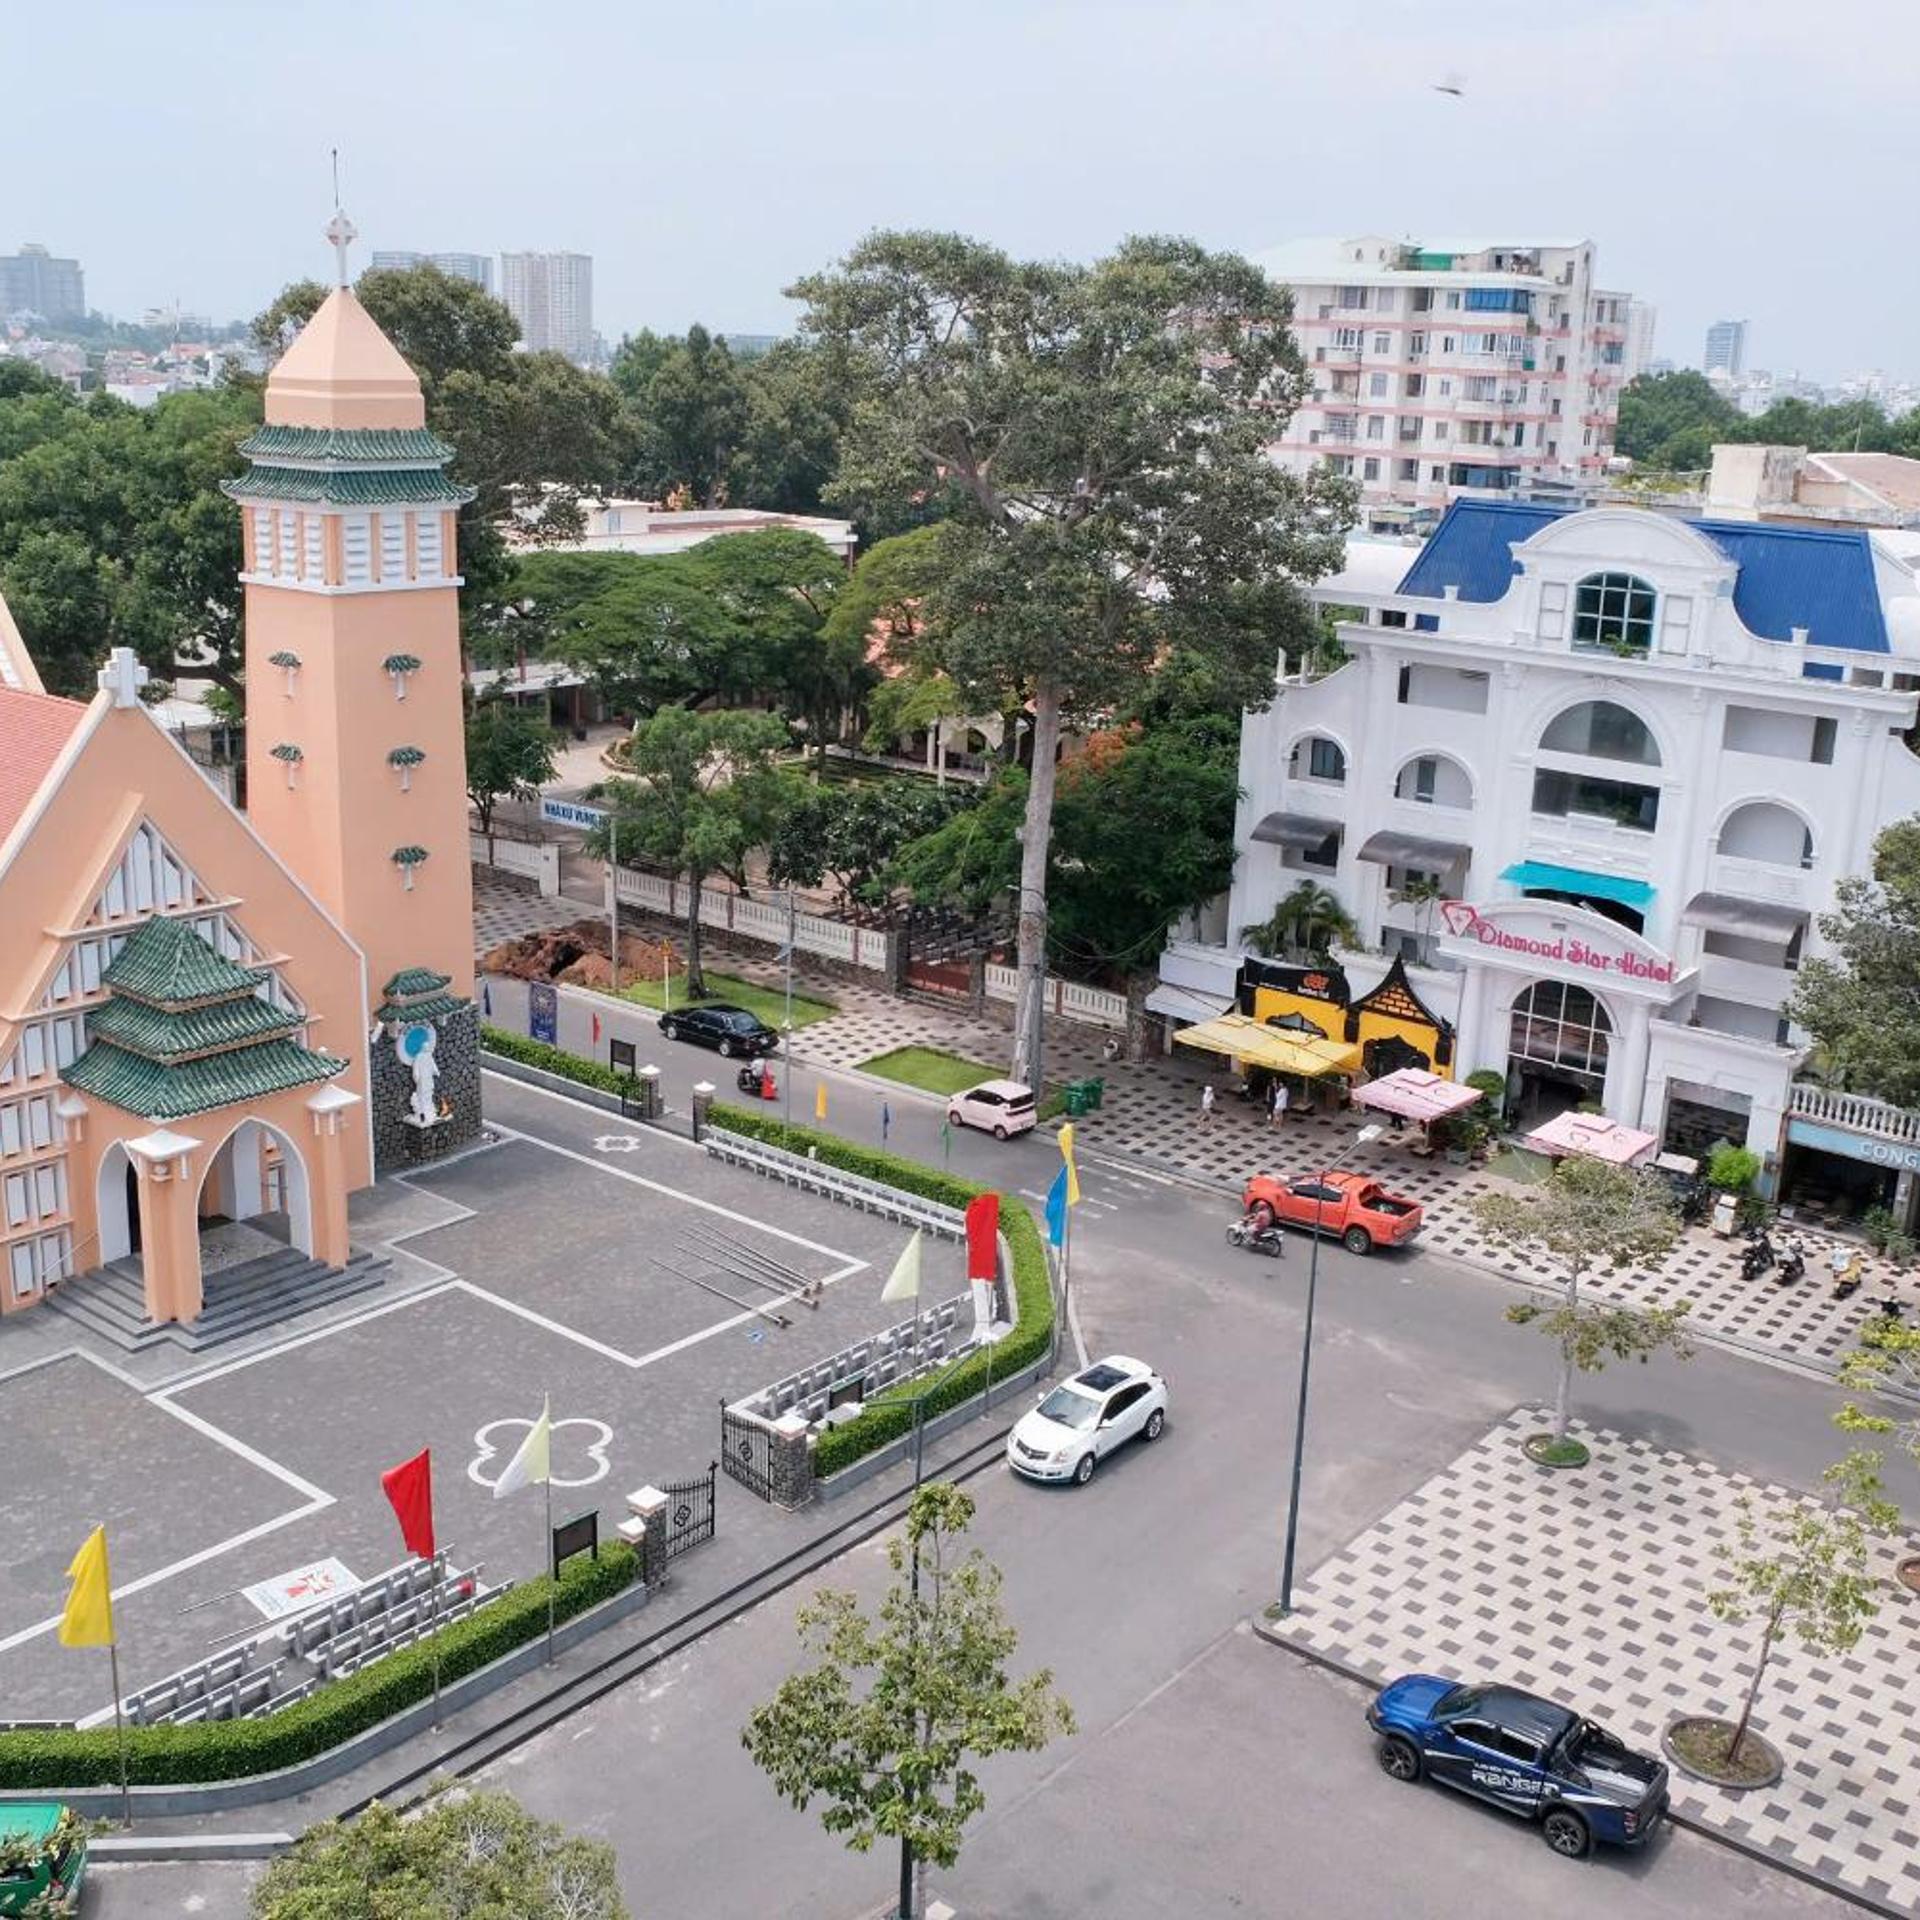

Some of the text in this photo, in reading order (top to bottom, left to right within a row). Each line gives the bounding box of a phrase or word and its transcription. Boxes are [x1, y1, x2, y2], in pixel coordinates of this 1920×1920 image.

[1479, 921, 1675, 984] Diamond Star Hotel
